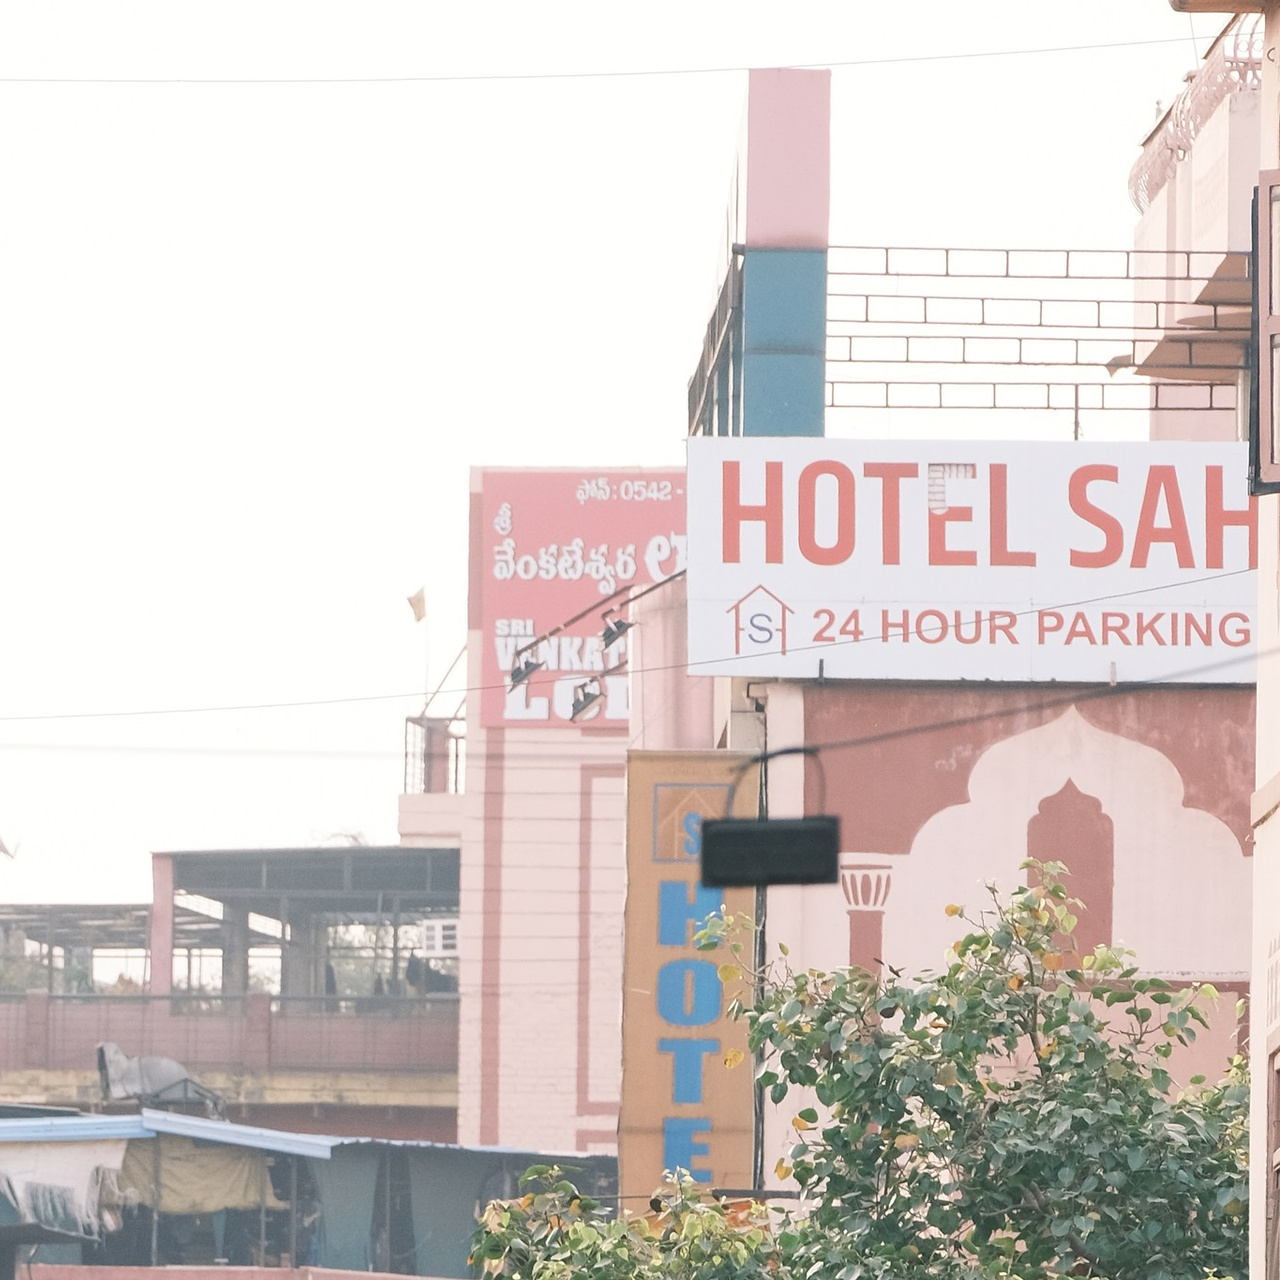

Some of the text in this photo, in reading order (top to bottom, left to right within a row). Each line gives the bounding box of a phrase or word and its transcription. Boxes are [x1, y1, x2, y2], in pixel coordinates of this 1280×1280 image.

[722, 459, 1037, 567] HOTEL
[495, 619, 534, 637] SRI
[812, 608, 1252, 648] 24 HOUR PARKING
